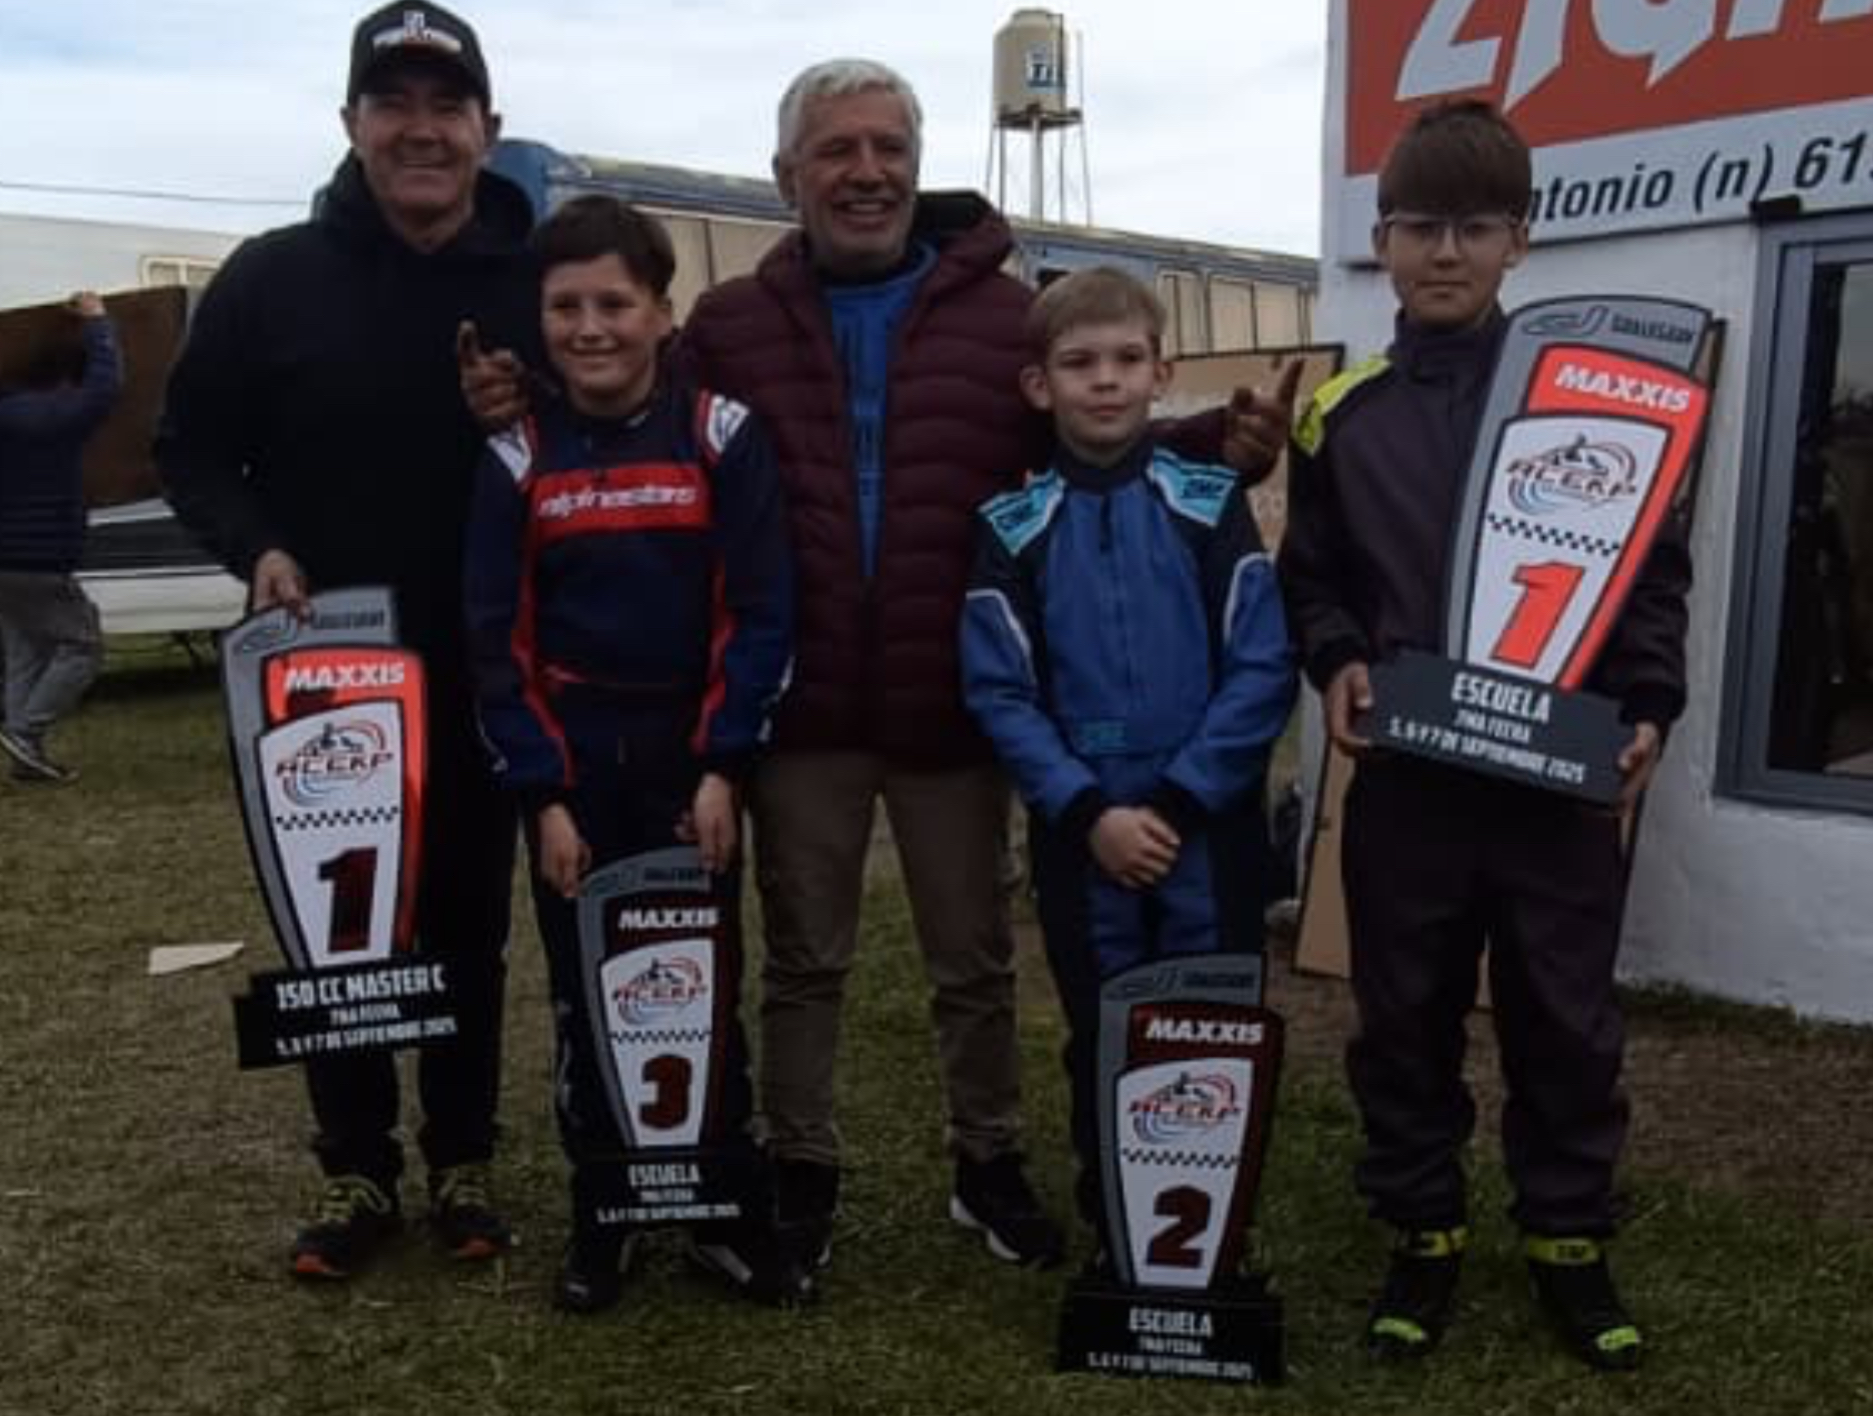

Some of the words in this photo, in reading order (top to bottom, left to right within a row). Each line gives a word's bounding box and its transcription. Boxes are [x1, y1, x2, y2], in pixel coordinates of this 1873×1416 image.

[1694, 142, 1774, 214] (n)
[1795, 131, 1873, 188] 61
[1555, 363, 1690, 412] MAXXIS
[1490, 562, 1585, 669] 1
[284, 661, 404, 692] MAXXIS
[1451, 671, 1552, 724] ESCUELA
[318, 846, 379, 954] 1
[618, 907, 719, 930] MAXXIS
[276, 979, 315, 1011] 150
[318, 976, 342, 1004] CC
[346, 966, 429, 1000] MASTER
[432, 964, 446, 990] C
[1146, 1018, 1264, 1045] MAXXIS
[638, 1053, 692, 1130] 3
[628, 1163, 700, 1188] ESCUELA
[1146, 1185, 1212, 1268] 2
[1128, 1307, 1212, 1338] ESCUELA
